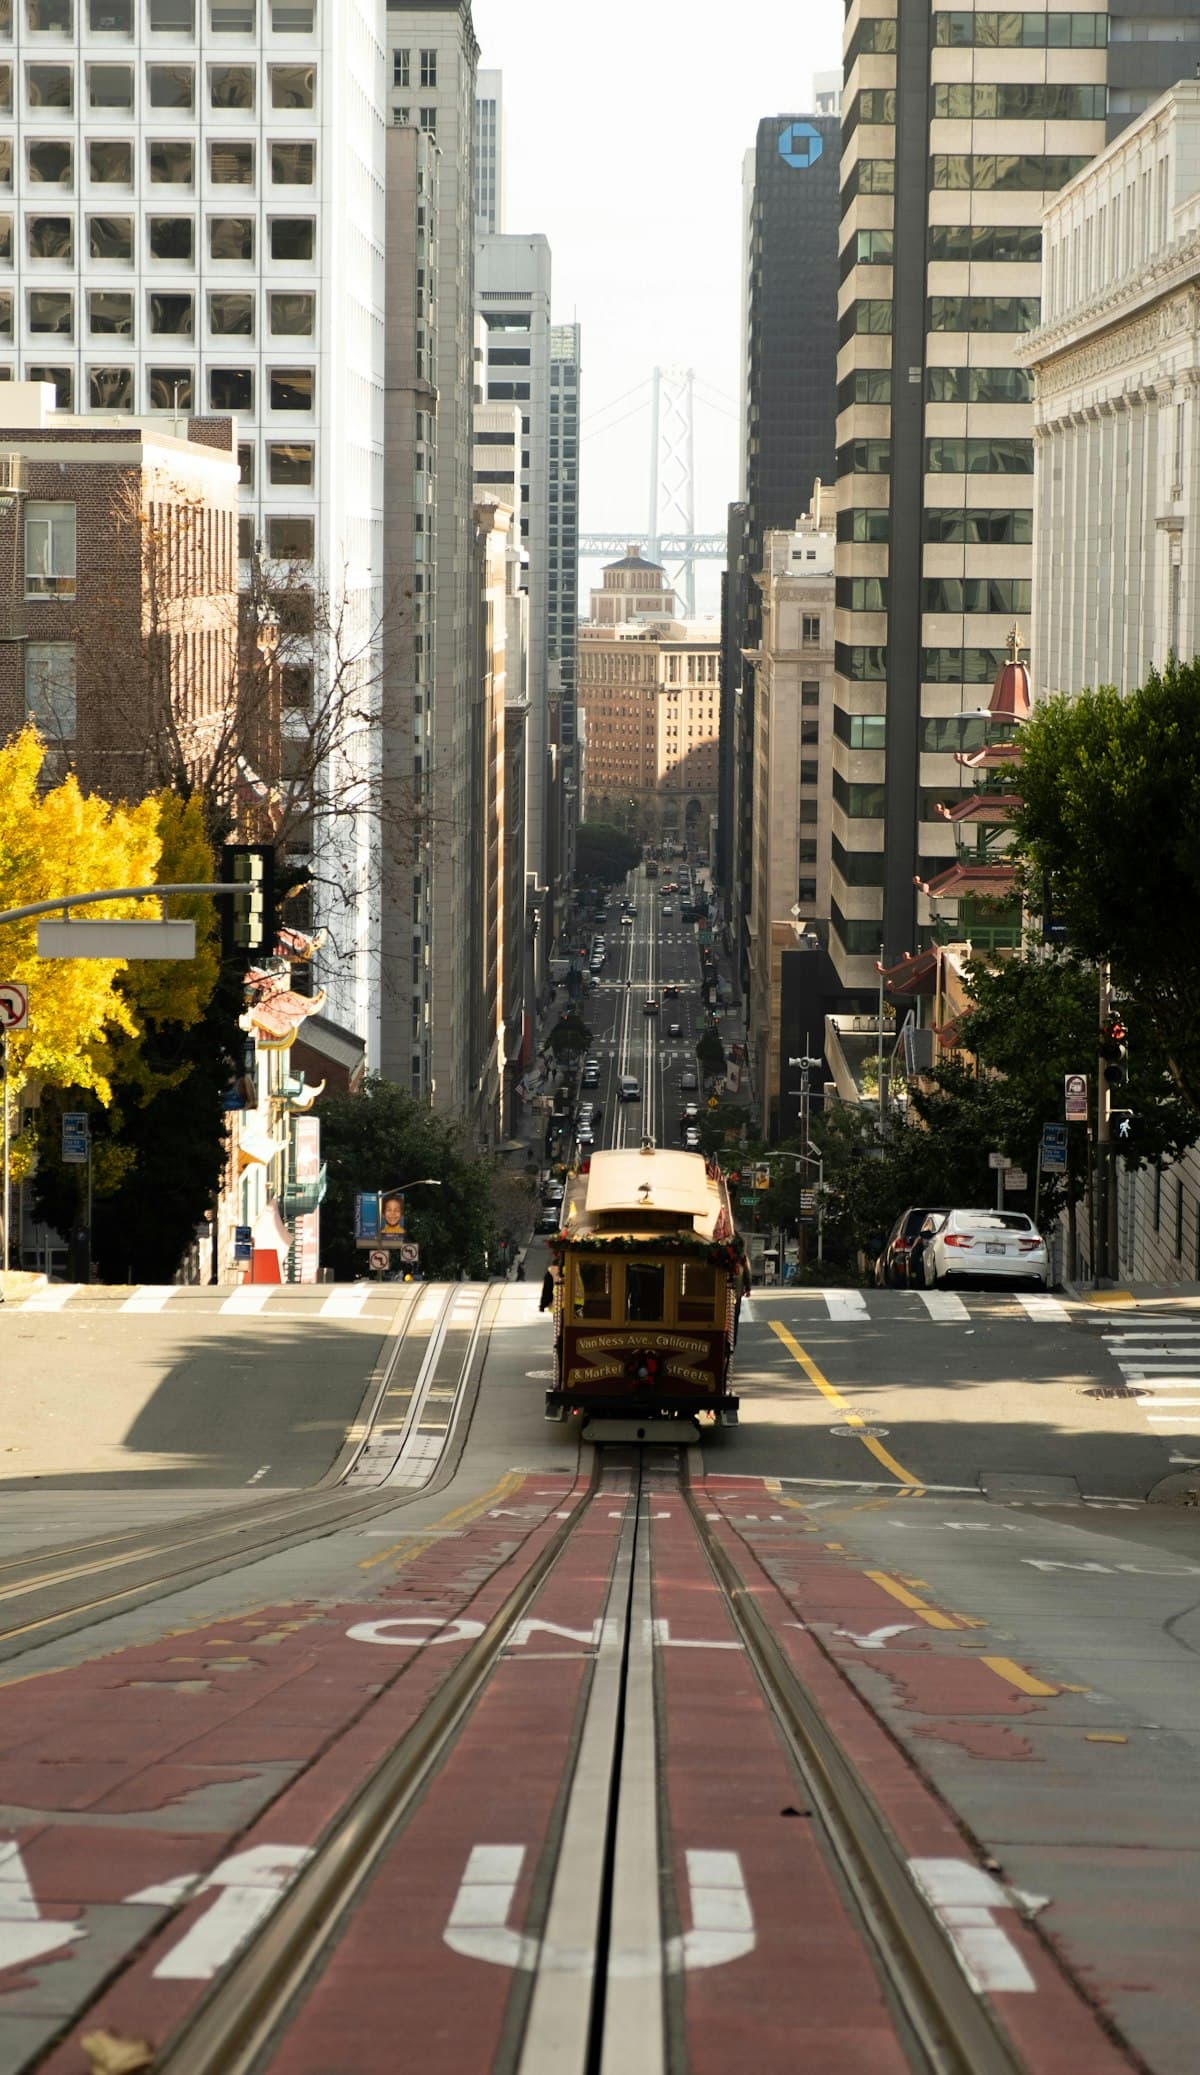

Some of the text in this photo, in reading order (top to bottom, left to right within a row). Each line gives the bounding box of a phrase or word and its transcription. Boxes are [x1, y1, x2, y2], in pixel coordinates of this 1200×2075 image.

[579, 1339, 598, 1349] Van
[598, 1336, 624, 1347] Ness
[656, 1335, 708, 1353] California
[574, 1369, 581, 1379] &
[584, 1364, 622, 1379] Market
[344, 1617, 918, 1650] ONLY
